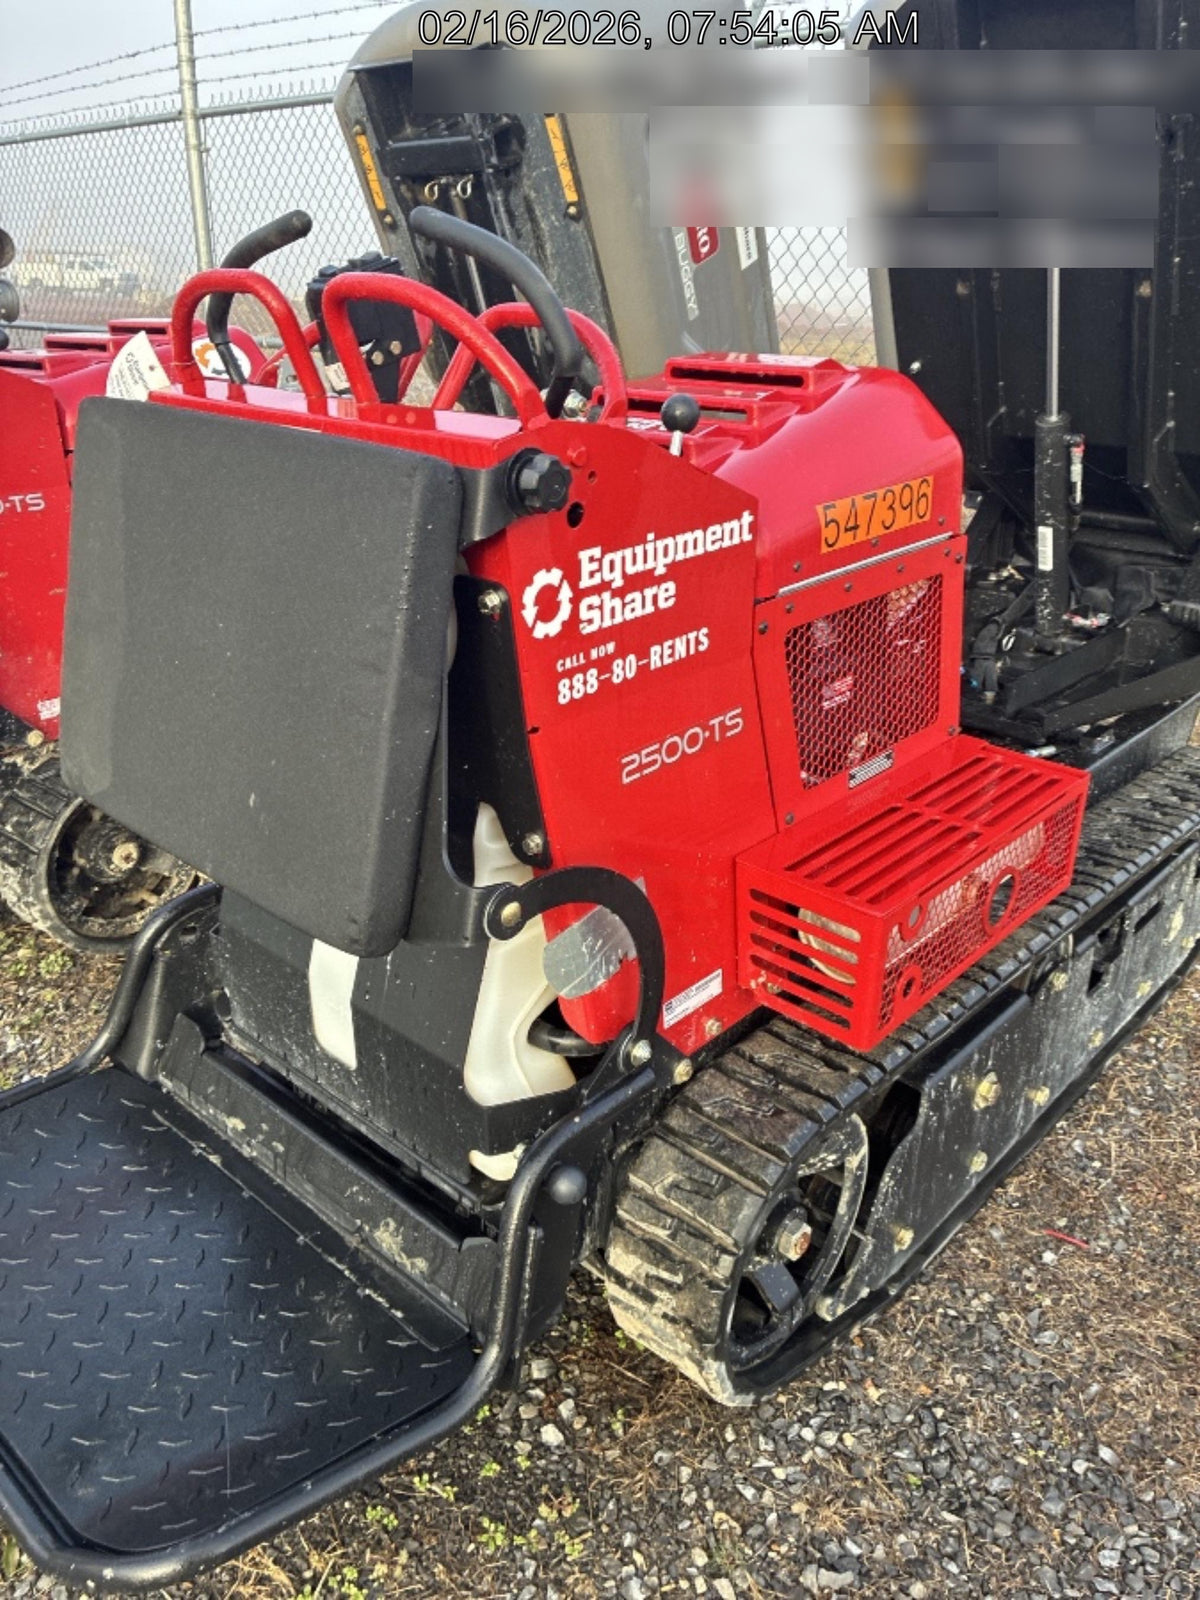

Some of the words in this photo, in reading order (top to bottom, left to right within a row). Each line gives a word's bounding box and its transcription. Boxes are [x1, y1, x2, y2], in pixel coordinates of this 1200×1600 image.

[823, 478, 930, 548] 547396
[578, 510, 754, 589] Equipment
[578, 580, 677, 635] Share
[556, 652, 586, 672] CALL
[590, 641, 616, 660] NOW
[557, 627, 709, 705] 888-80-RENTS
